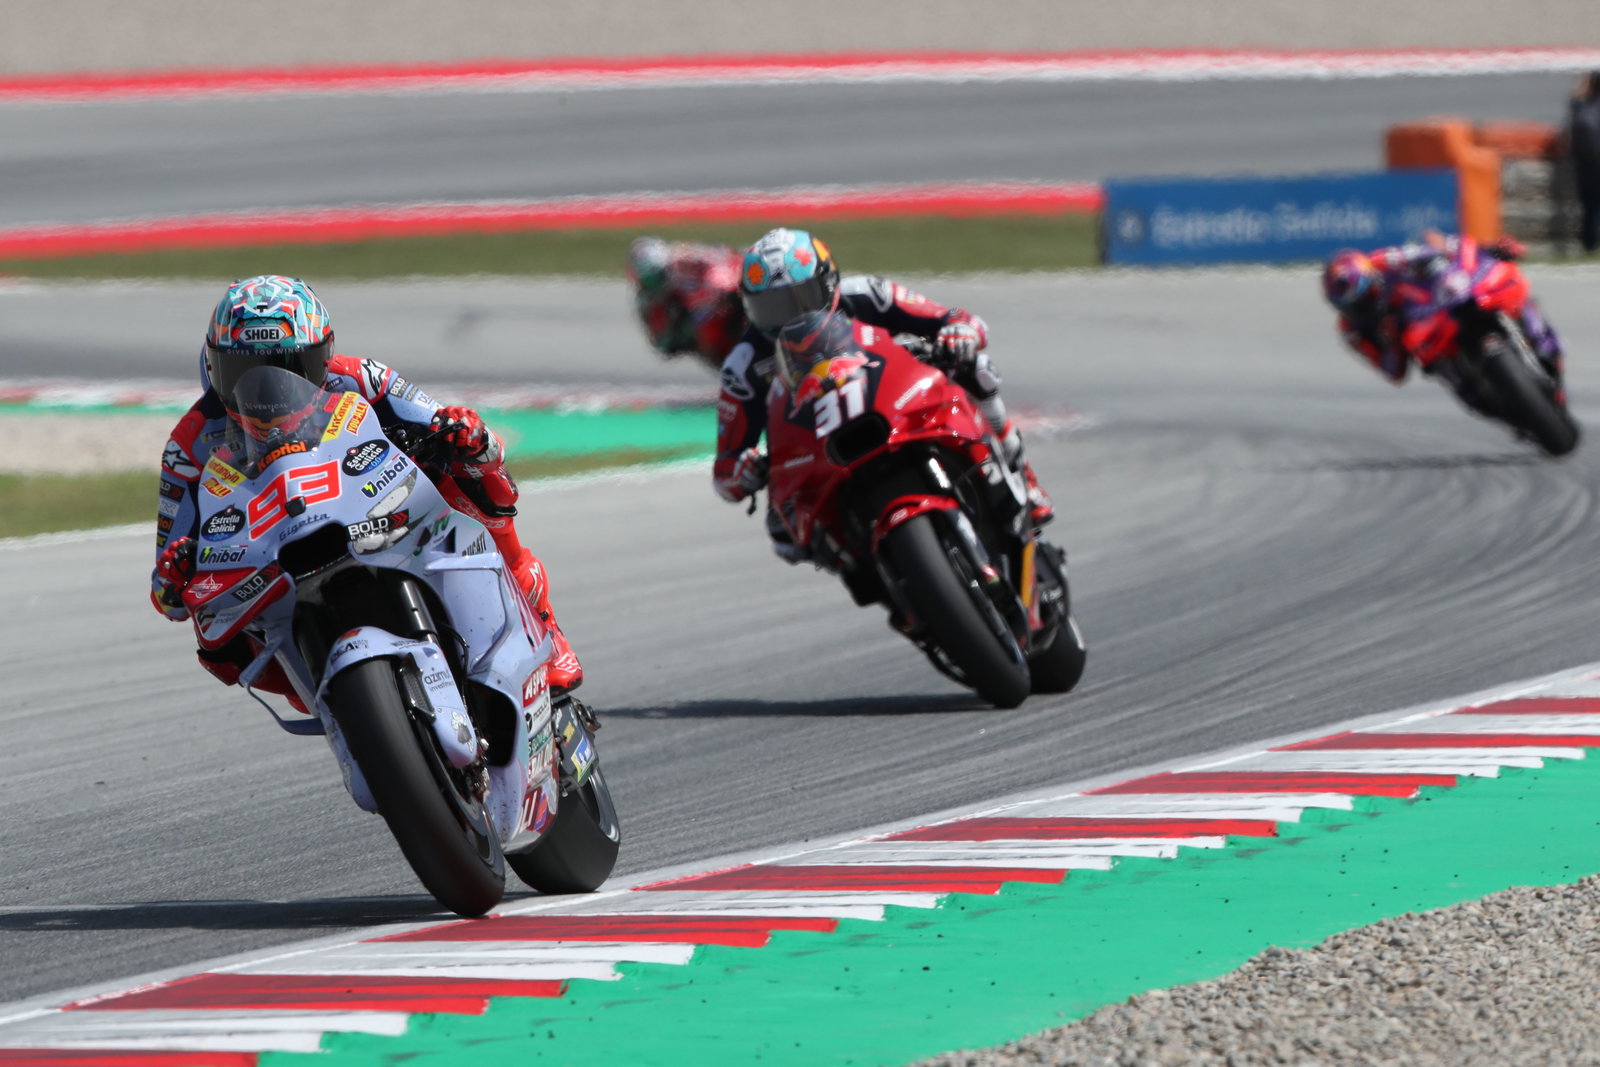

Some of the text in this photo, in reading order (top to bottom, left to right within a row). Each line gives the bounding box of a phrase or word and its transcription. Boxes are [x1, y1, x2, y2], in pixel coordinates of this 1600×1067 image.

[245, 328, 279, 341] SHOEI
[226, 348, 250, 356] GIVES
[276, 346, 305, 355] WINGS
[390, 377, 406, 397] BOLD
[814, 377, 865, 440] 31
[346, 443, 377, 469] Estrella
[355, 447, 384, 471] Galicia
[360, 455, 408, 498] Unibat
[249, 460, 340, 540] 93
[208, 524, 235, 534] Galicia
[210, 515, 240, 525] Estrella
[348, 518, 388, 536] BOLD
[199, 547, 246, 564] Unibat
[235, 575, 264, 598] BOLD
